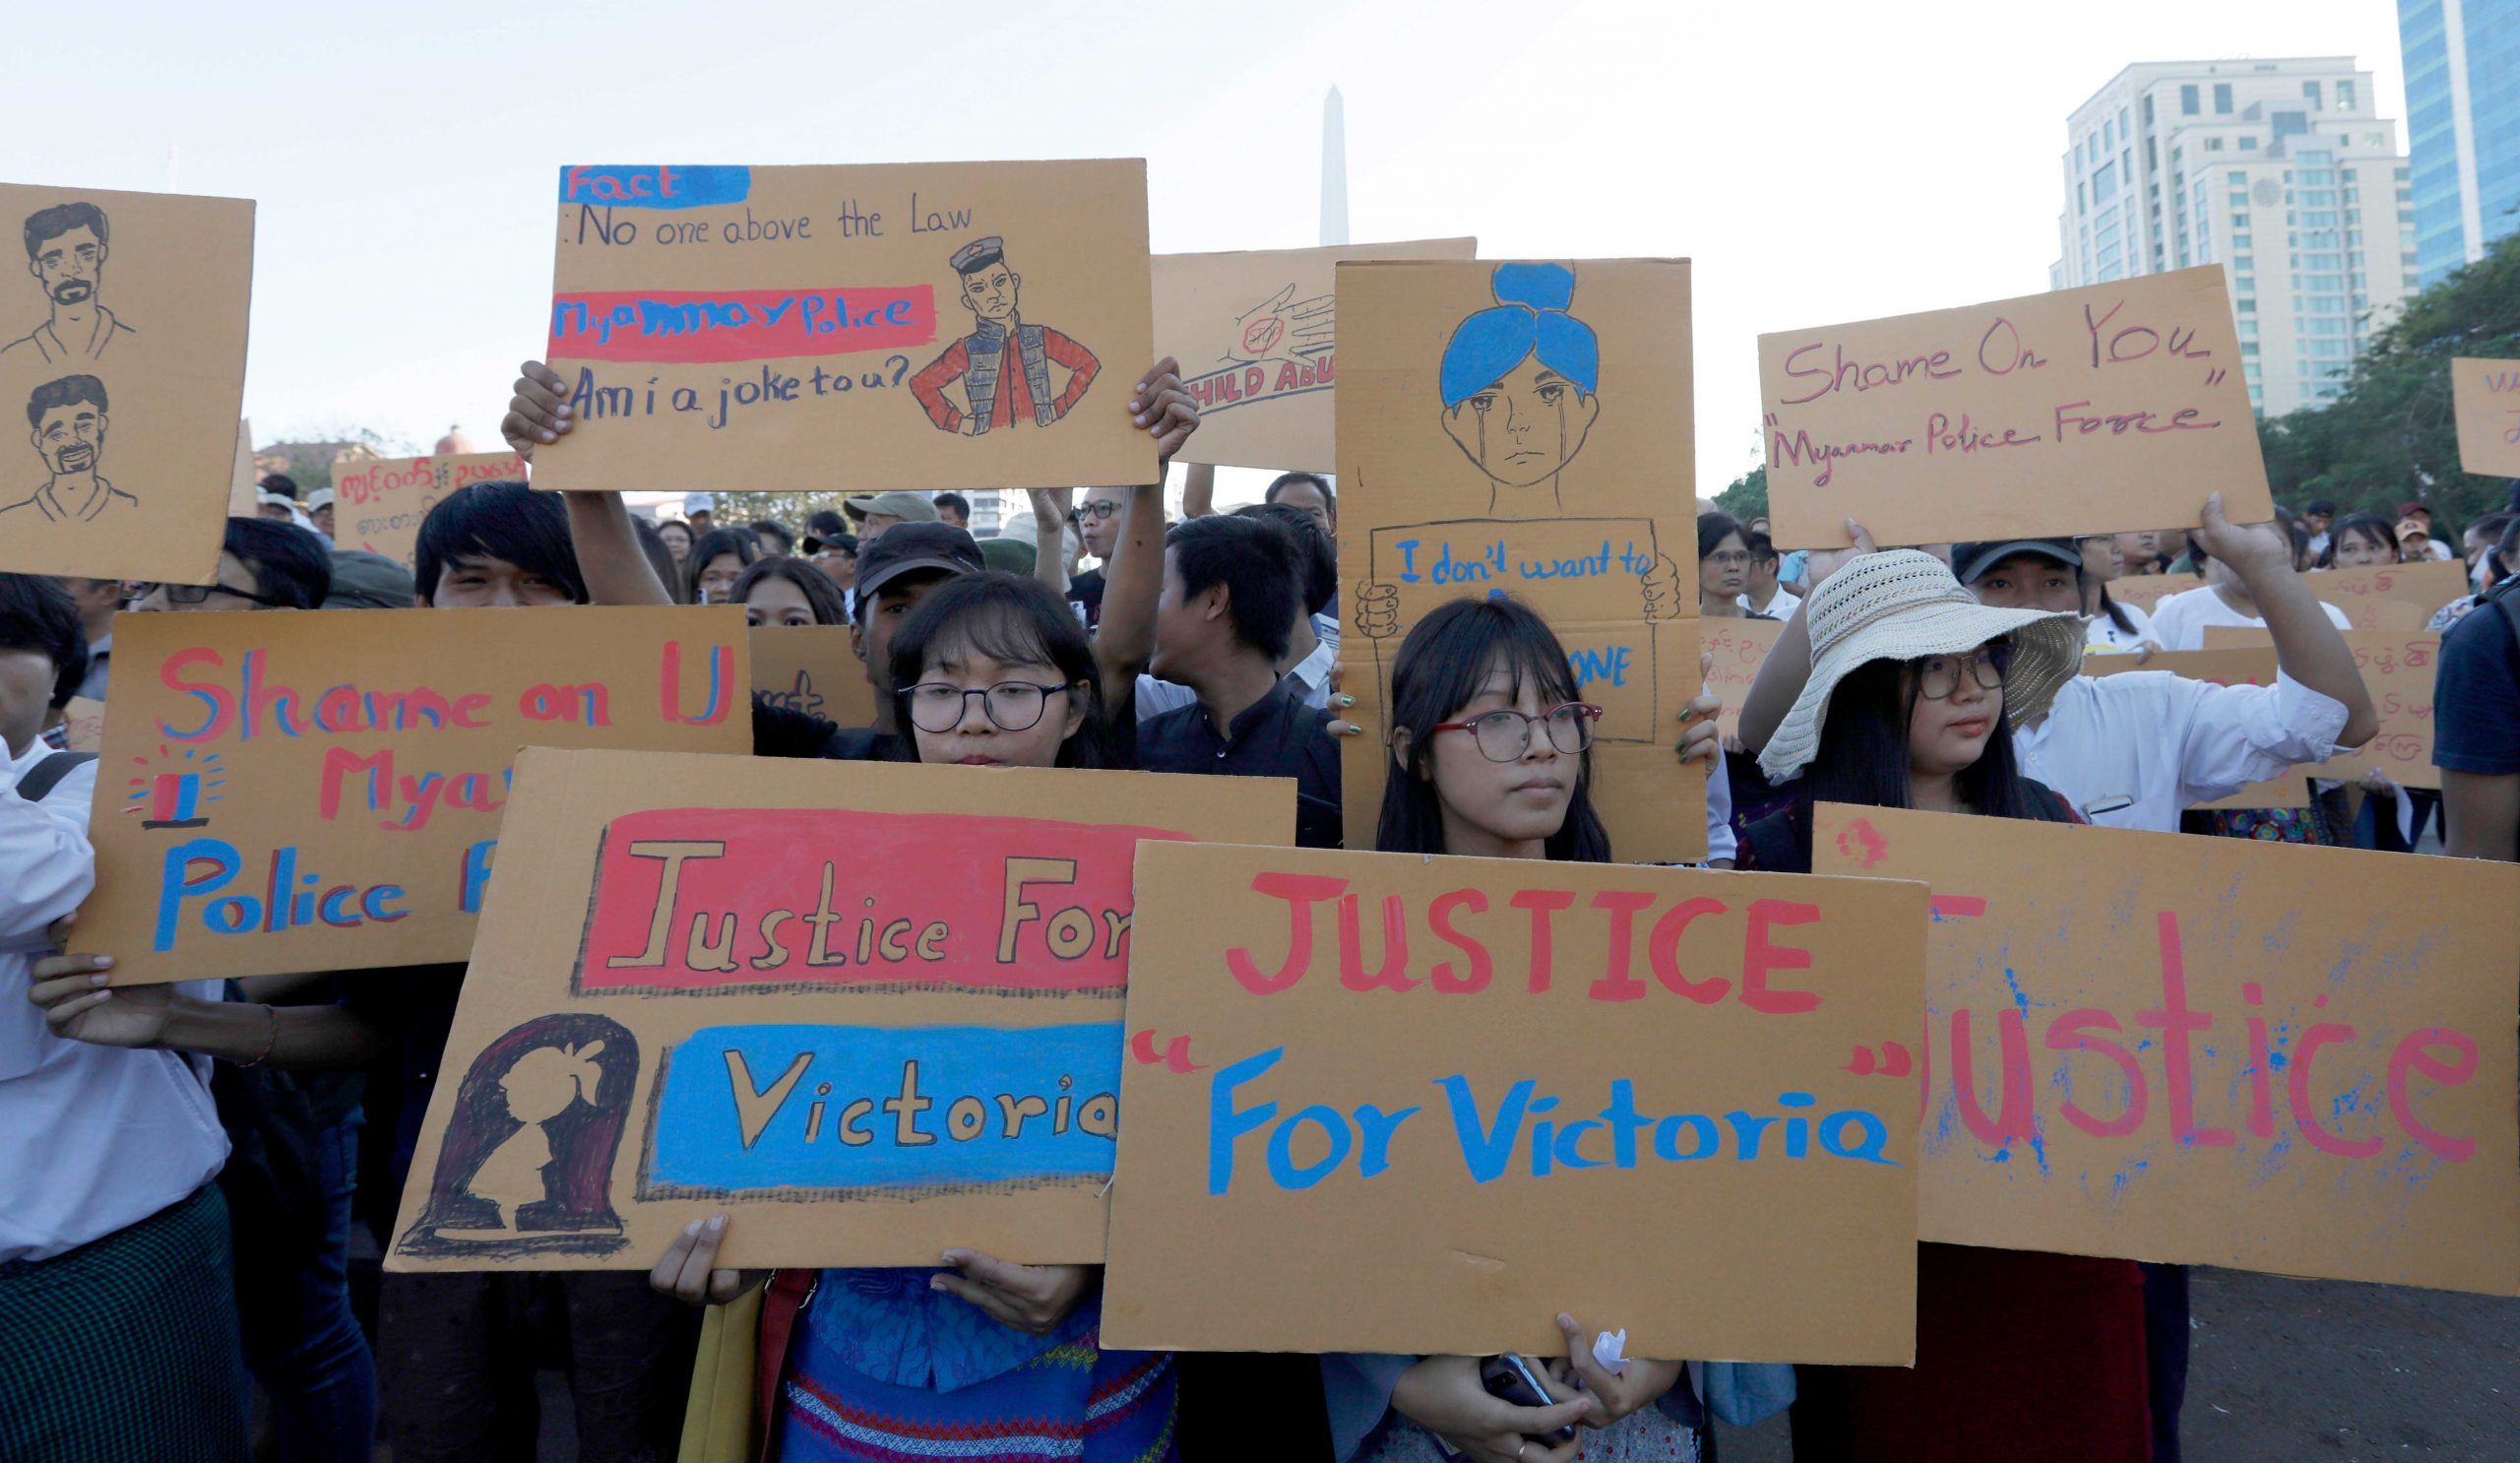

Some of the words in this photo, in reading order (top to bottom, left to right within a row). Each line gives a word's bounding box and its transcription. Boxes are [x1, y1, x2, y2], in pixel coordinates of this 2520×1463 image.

[567, 165, 679, 200] Fact
[657, 219, 709, 244] one
[724, 207, 812, 244] above
[838, 199, 884, 237] the
[912, 192, 972, 234] Law
[802, 295, 918, 337] Police
[569, 366, 633, 419] Am
[671, 388, 703, 413] a
[707, 364, 800, 429] joke
[809, 365, 853, 396] to
[1184, 366, 1266, 407] HILD
[1274, 354, 1334, 392] ABU
[1781, 344, 1962, 404] Shame
[1979, 317, 2048, 375] On
[1926, 413, 2042, 457] Police
[1396, 540, 1421, 583] I
[1430, 540, 1507, 585] don't
[1519, 540, 1611, 580] want
[1618, 541, 1652, 575] to
[155, 647, 492, 744] Shame
[518, 681, 612, 728] on
[661, 641, 735, 726] U
[319, 747, 514, 832] Mya
[154, 838, 412, 953] Police
[605, 840, 949, 974] Justice
[996, 857, 1133, 964] For
[1227, 872, 1826, 1014] JUSTICE
[1921, 894, 2480, 1162] ustice
[723, 1049, 1120, 1150] Victoria
